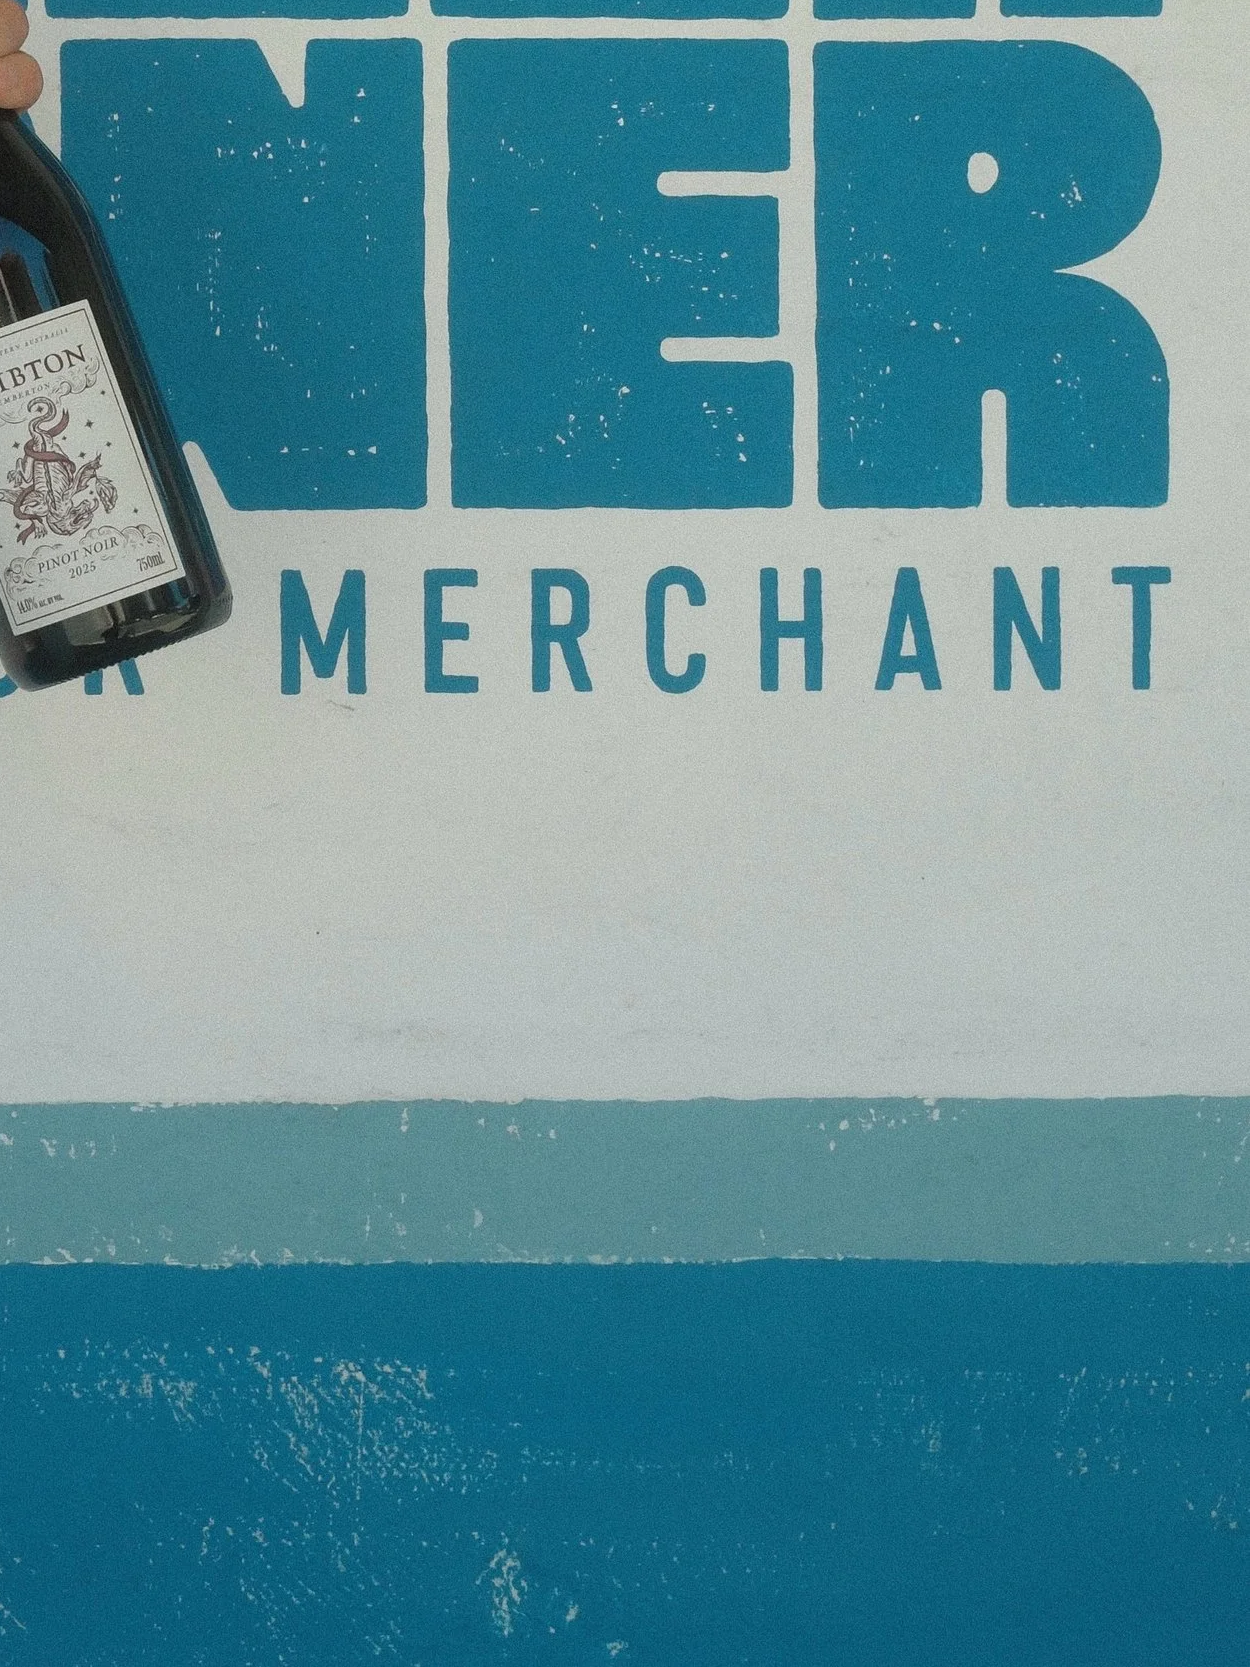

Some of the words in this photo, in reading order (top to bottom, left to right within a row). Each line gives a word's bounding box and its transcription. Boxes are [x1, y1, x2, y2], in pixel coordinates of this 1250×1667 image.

[38, 549, 79, 573] PINOT
[83, 536, 119, 557] NOIR
[69, 561, 96, 579] 2025
[281, 566, 1172, 694] MERCHANT
